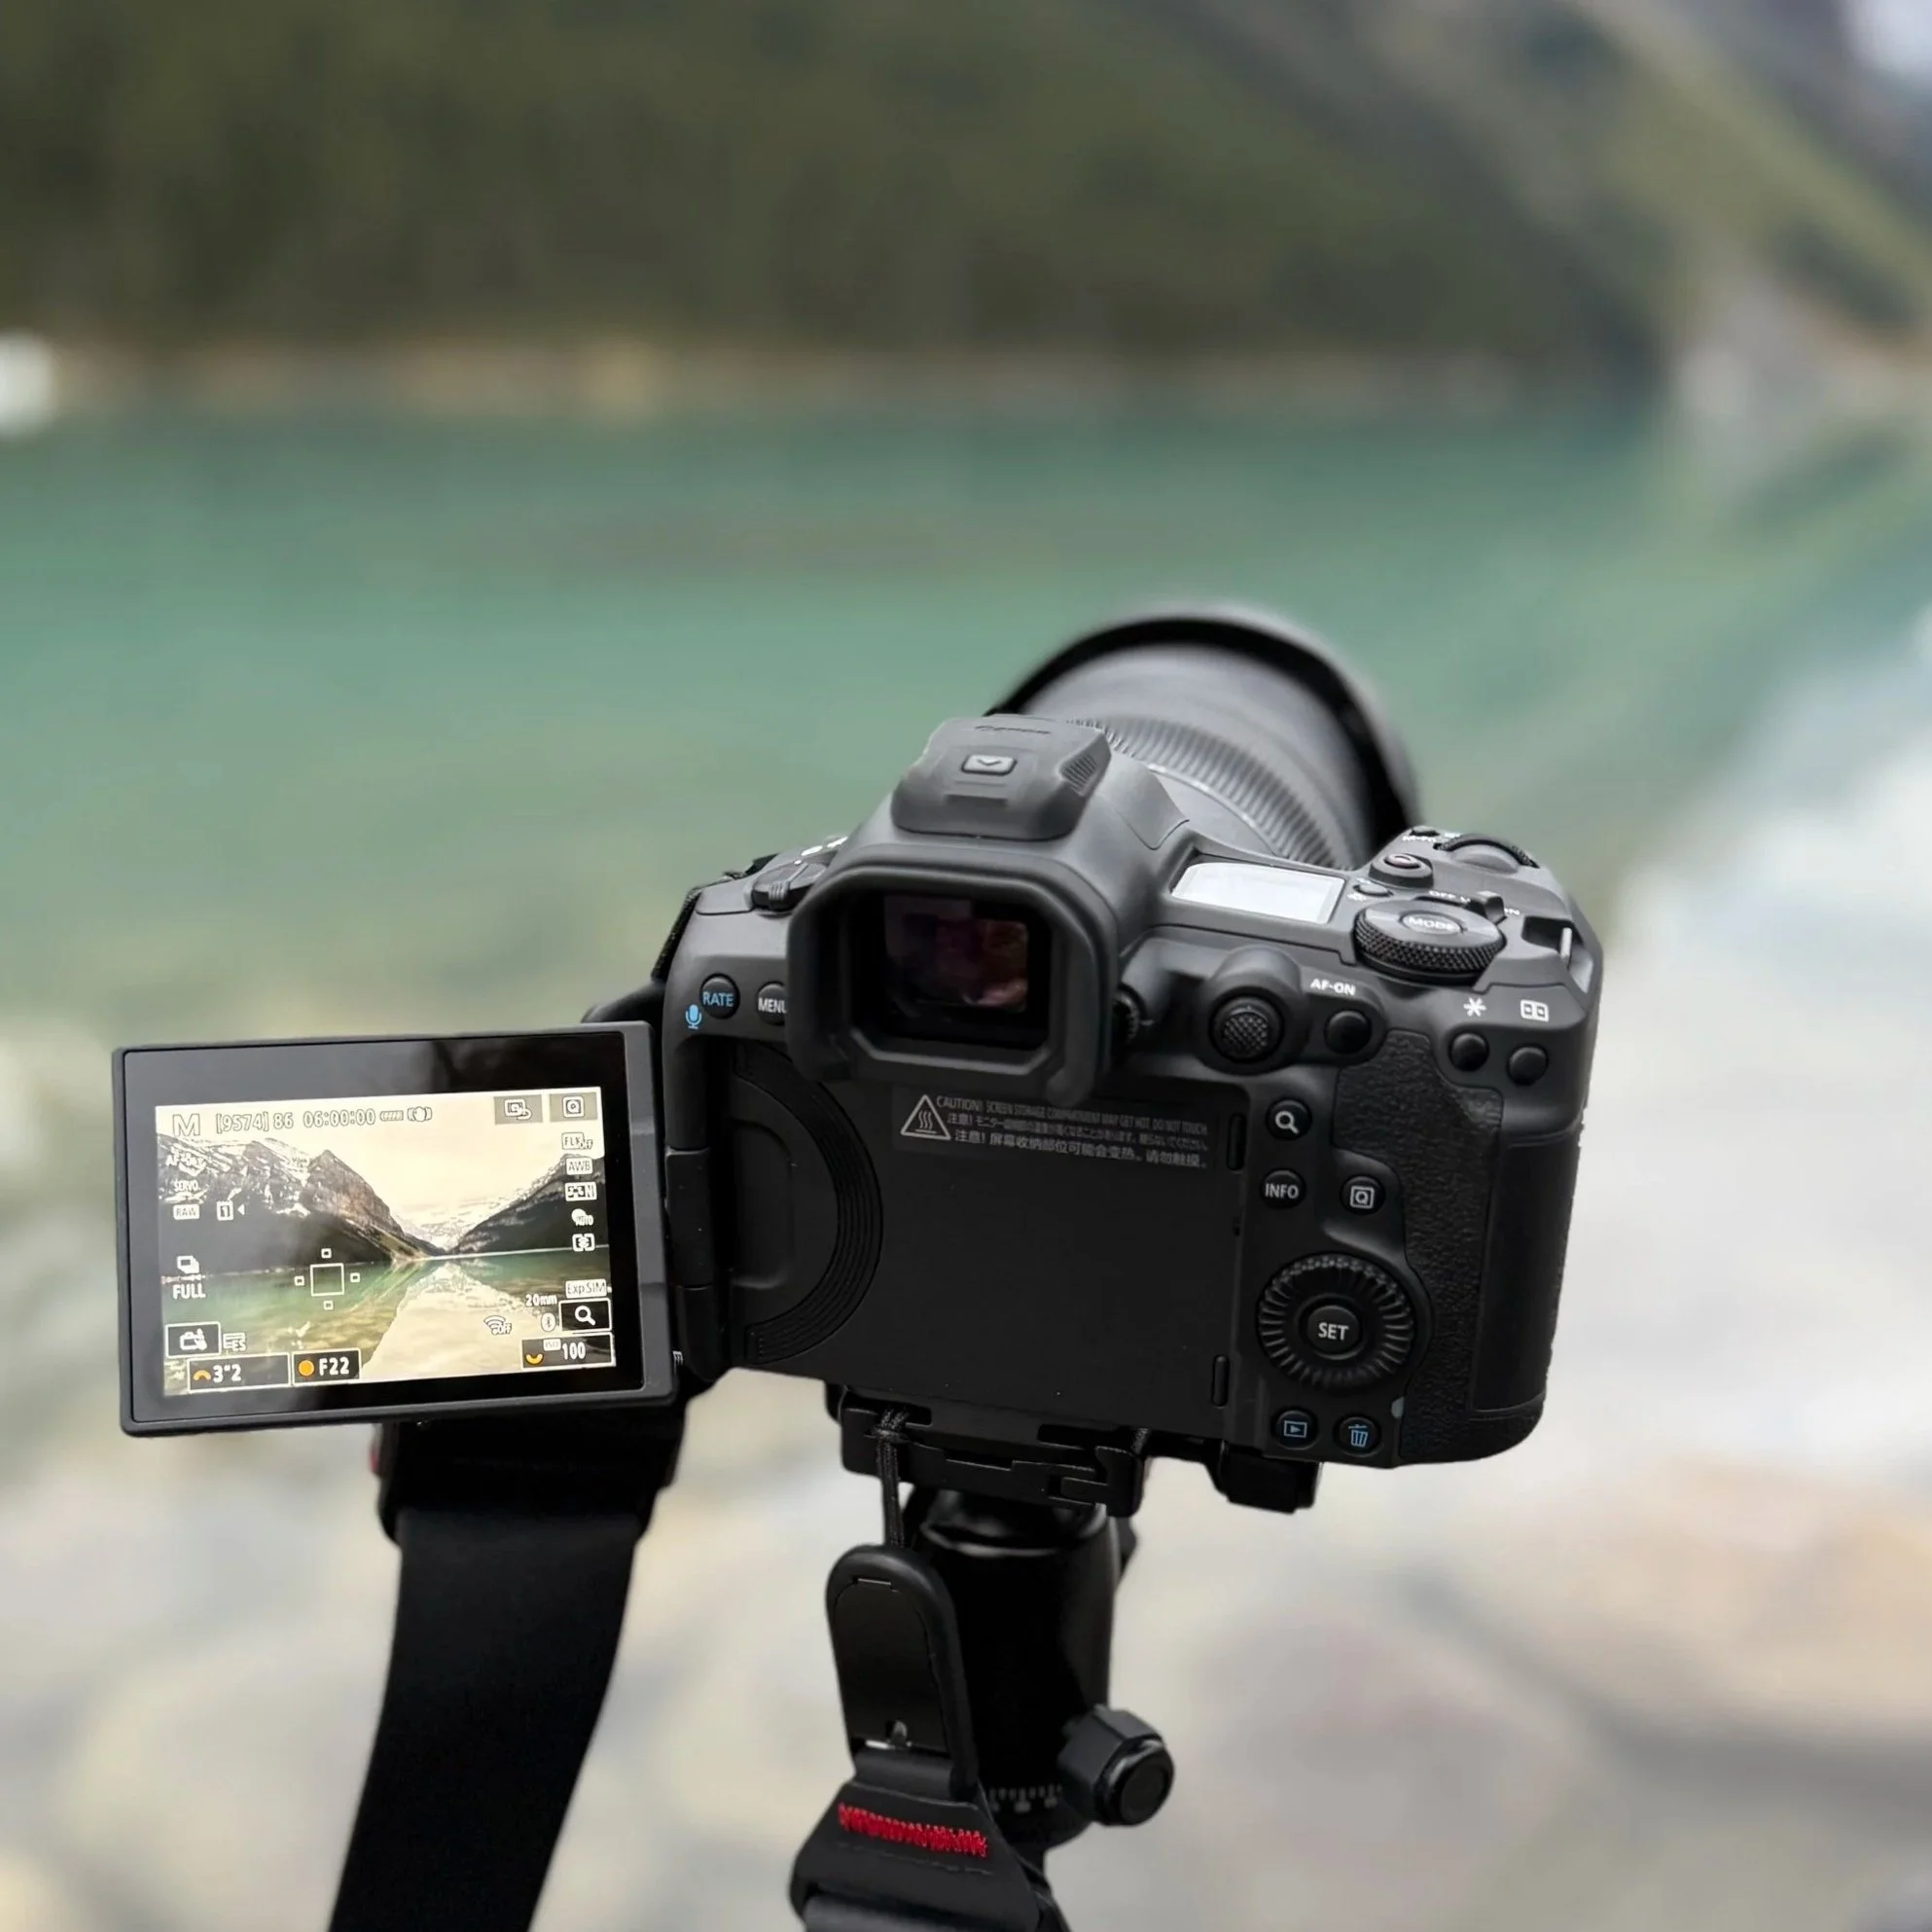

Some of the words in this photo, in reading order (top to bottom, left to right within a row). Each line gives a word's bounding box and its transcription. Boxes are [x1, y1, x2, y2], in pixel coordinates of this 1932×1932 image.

[1310, 978, 1355, 995] AF-ON
[702, 992, 734, 1007] RATE
[173, 1114, 200, 1136] M
[304, 1108, 376, 1128] 06:00:00
[568, 1160, 591, 1172] AWB
[173, 1180, 199, 1193] SERVO
[1266, 1183, 1299, 1199] INFO
[172, 1283, 206, 1300] FULL
[525, 1294, 557, 1307] 20mm
[1318, 1322, 1349, 1341] SET
[562, 1342, 586, 1360] 100
[319, 1356, 350, 1377] F22
